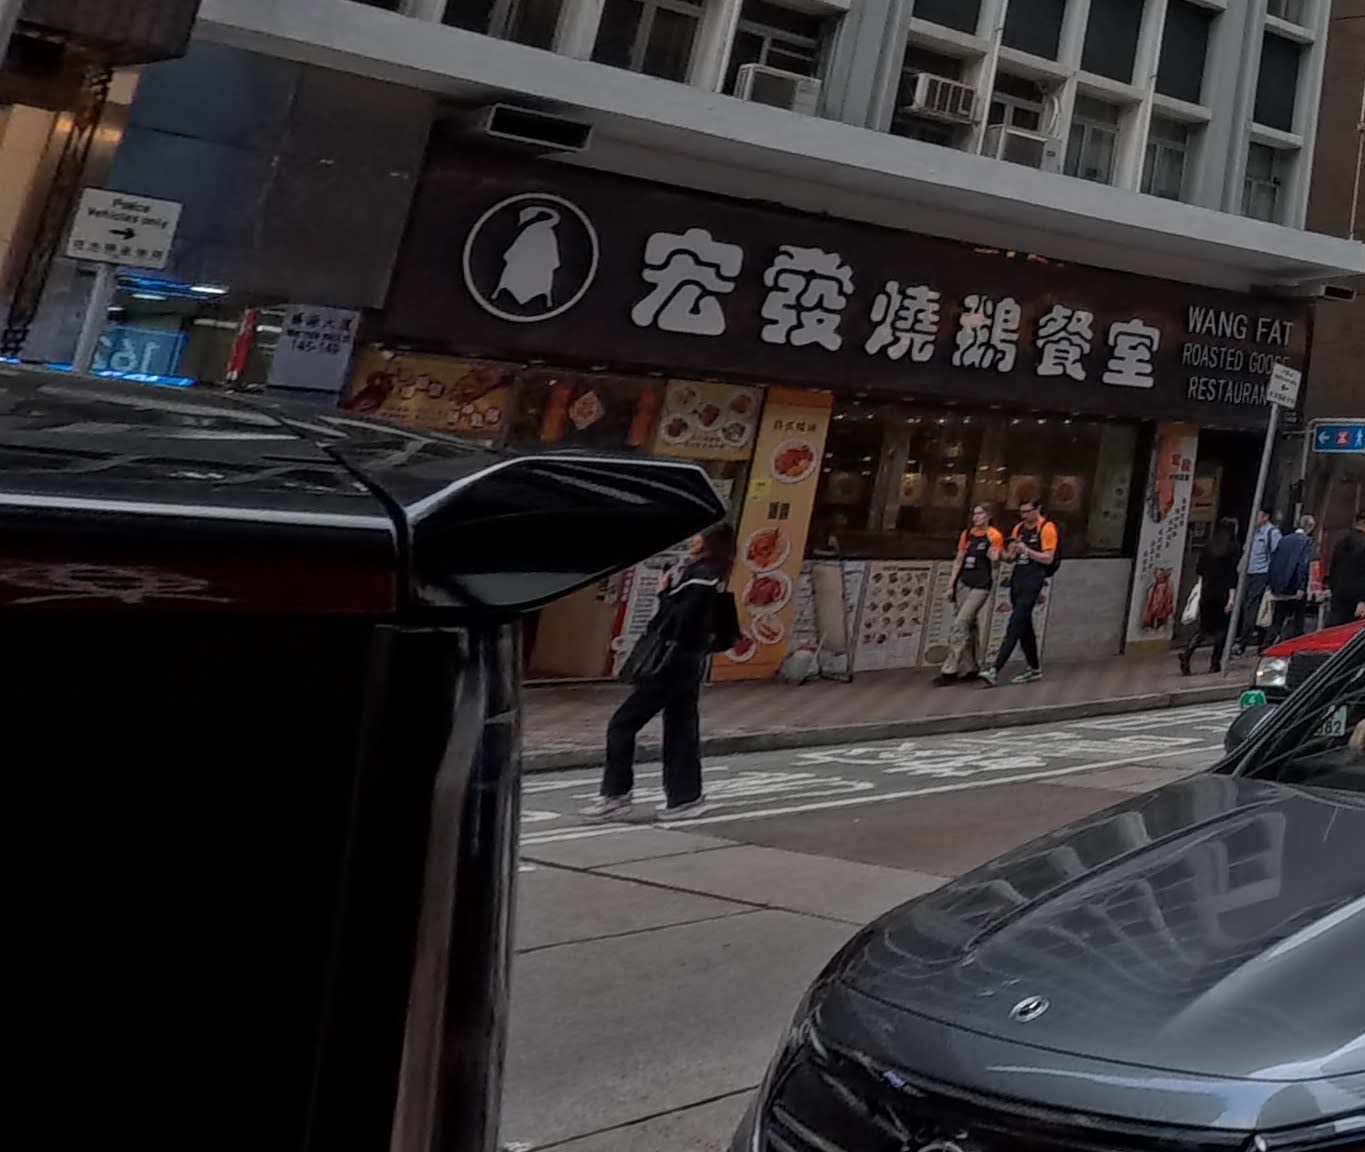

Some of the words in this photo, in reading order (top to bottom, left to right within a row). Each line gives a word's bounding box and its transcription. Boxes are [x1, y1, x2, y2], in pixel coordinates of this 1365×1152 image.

[631, 227, 1161, 388] 宏發燒鵝餐室
[1188, 305, 1248, 340] WANG
[1256, 318, 1295, 346] FAT
[1182, 342, 1244, 371] ROASTED
[1187, 376, 1268, 407] RESTAURAN
